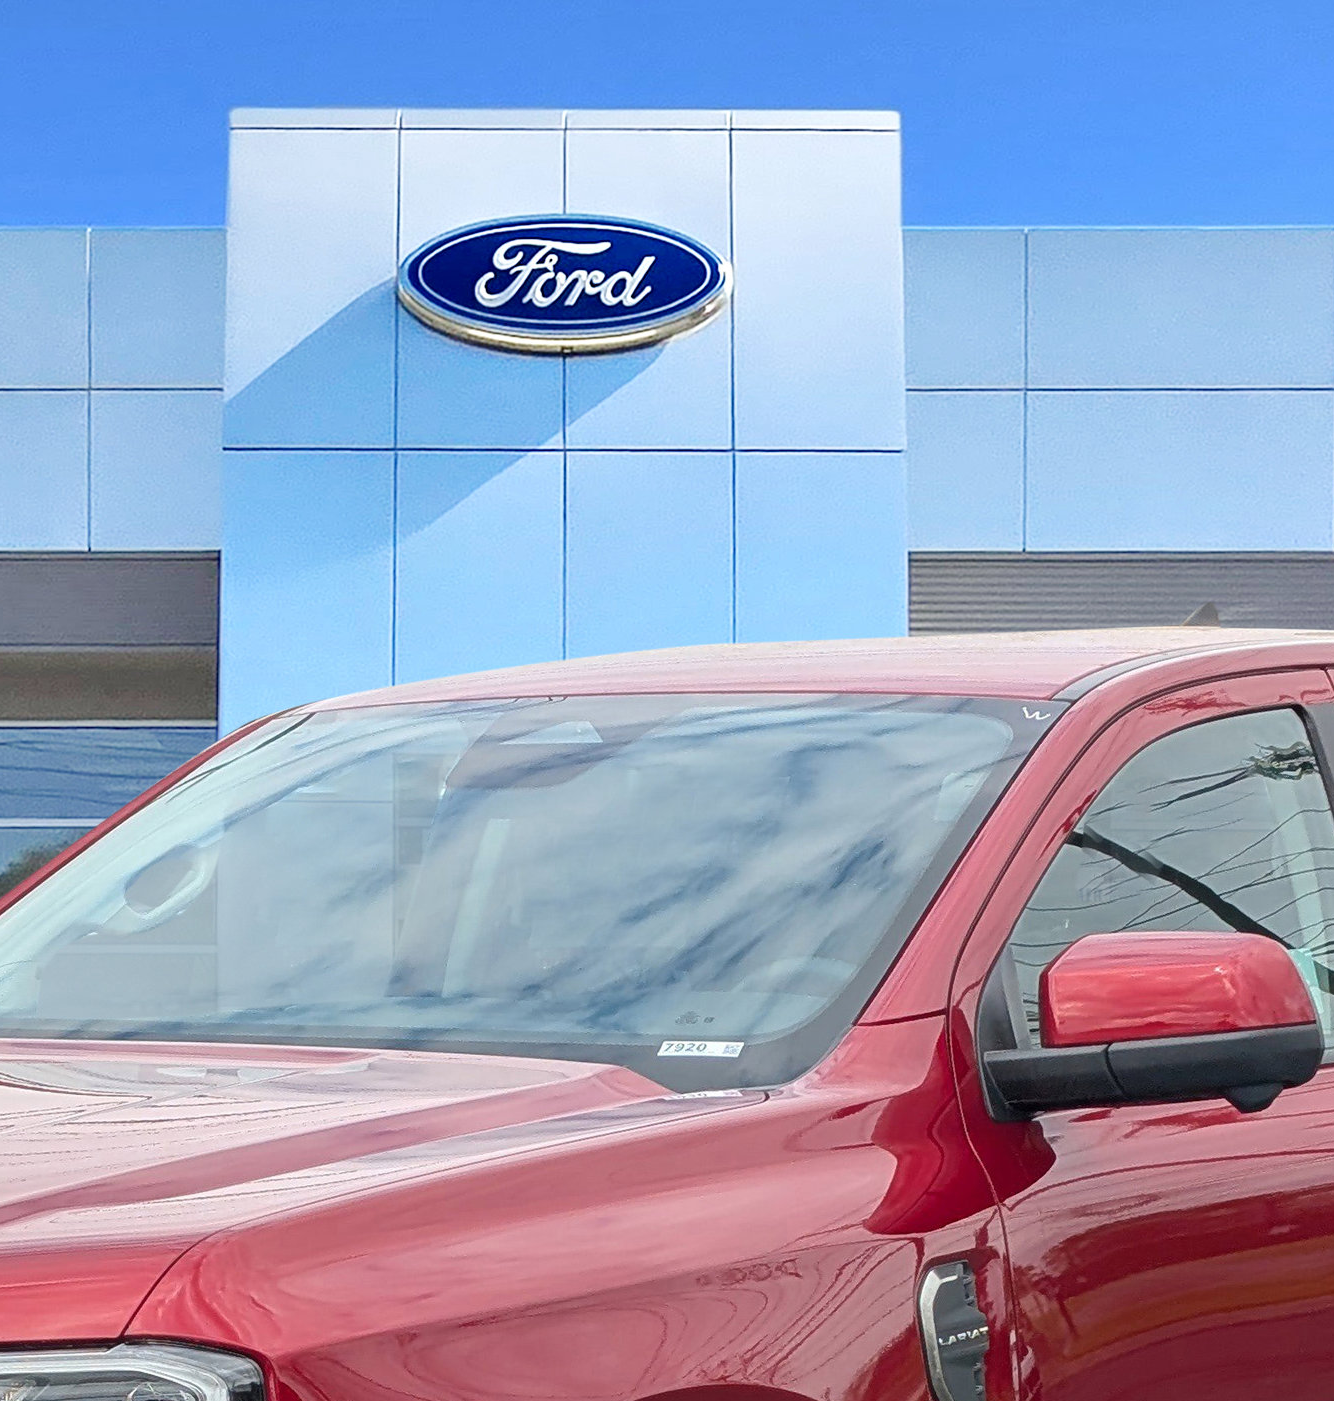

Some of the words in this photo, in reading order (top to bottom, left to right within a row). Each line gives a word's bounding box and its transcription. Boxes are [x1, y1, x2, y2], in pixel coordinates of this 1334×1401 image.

[474, 238, 656, 308] Ford
[663, 1042, 708, 1052] 7920
[938, 1326, 989, 1346] LARIAT
